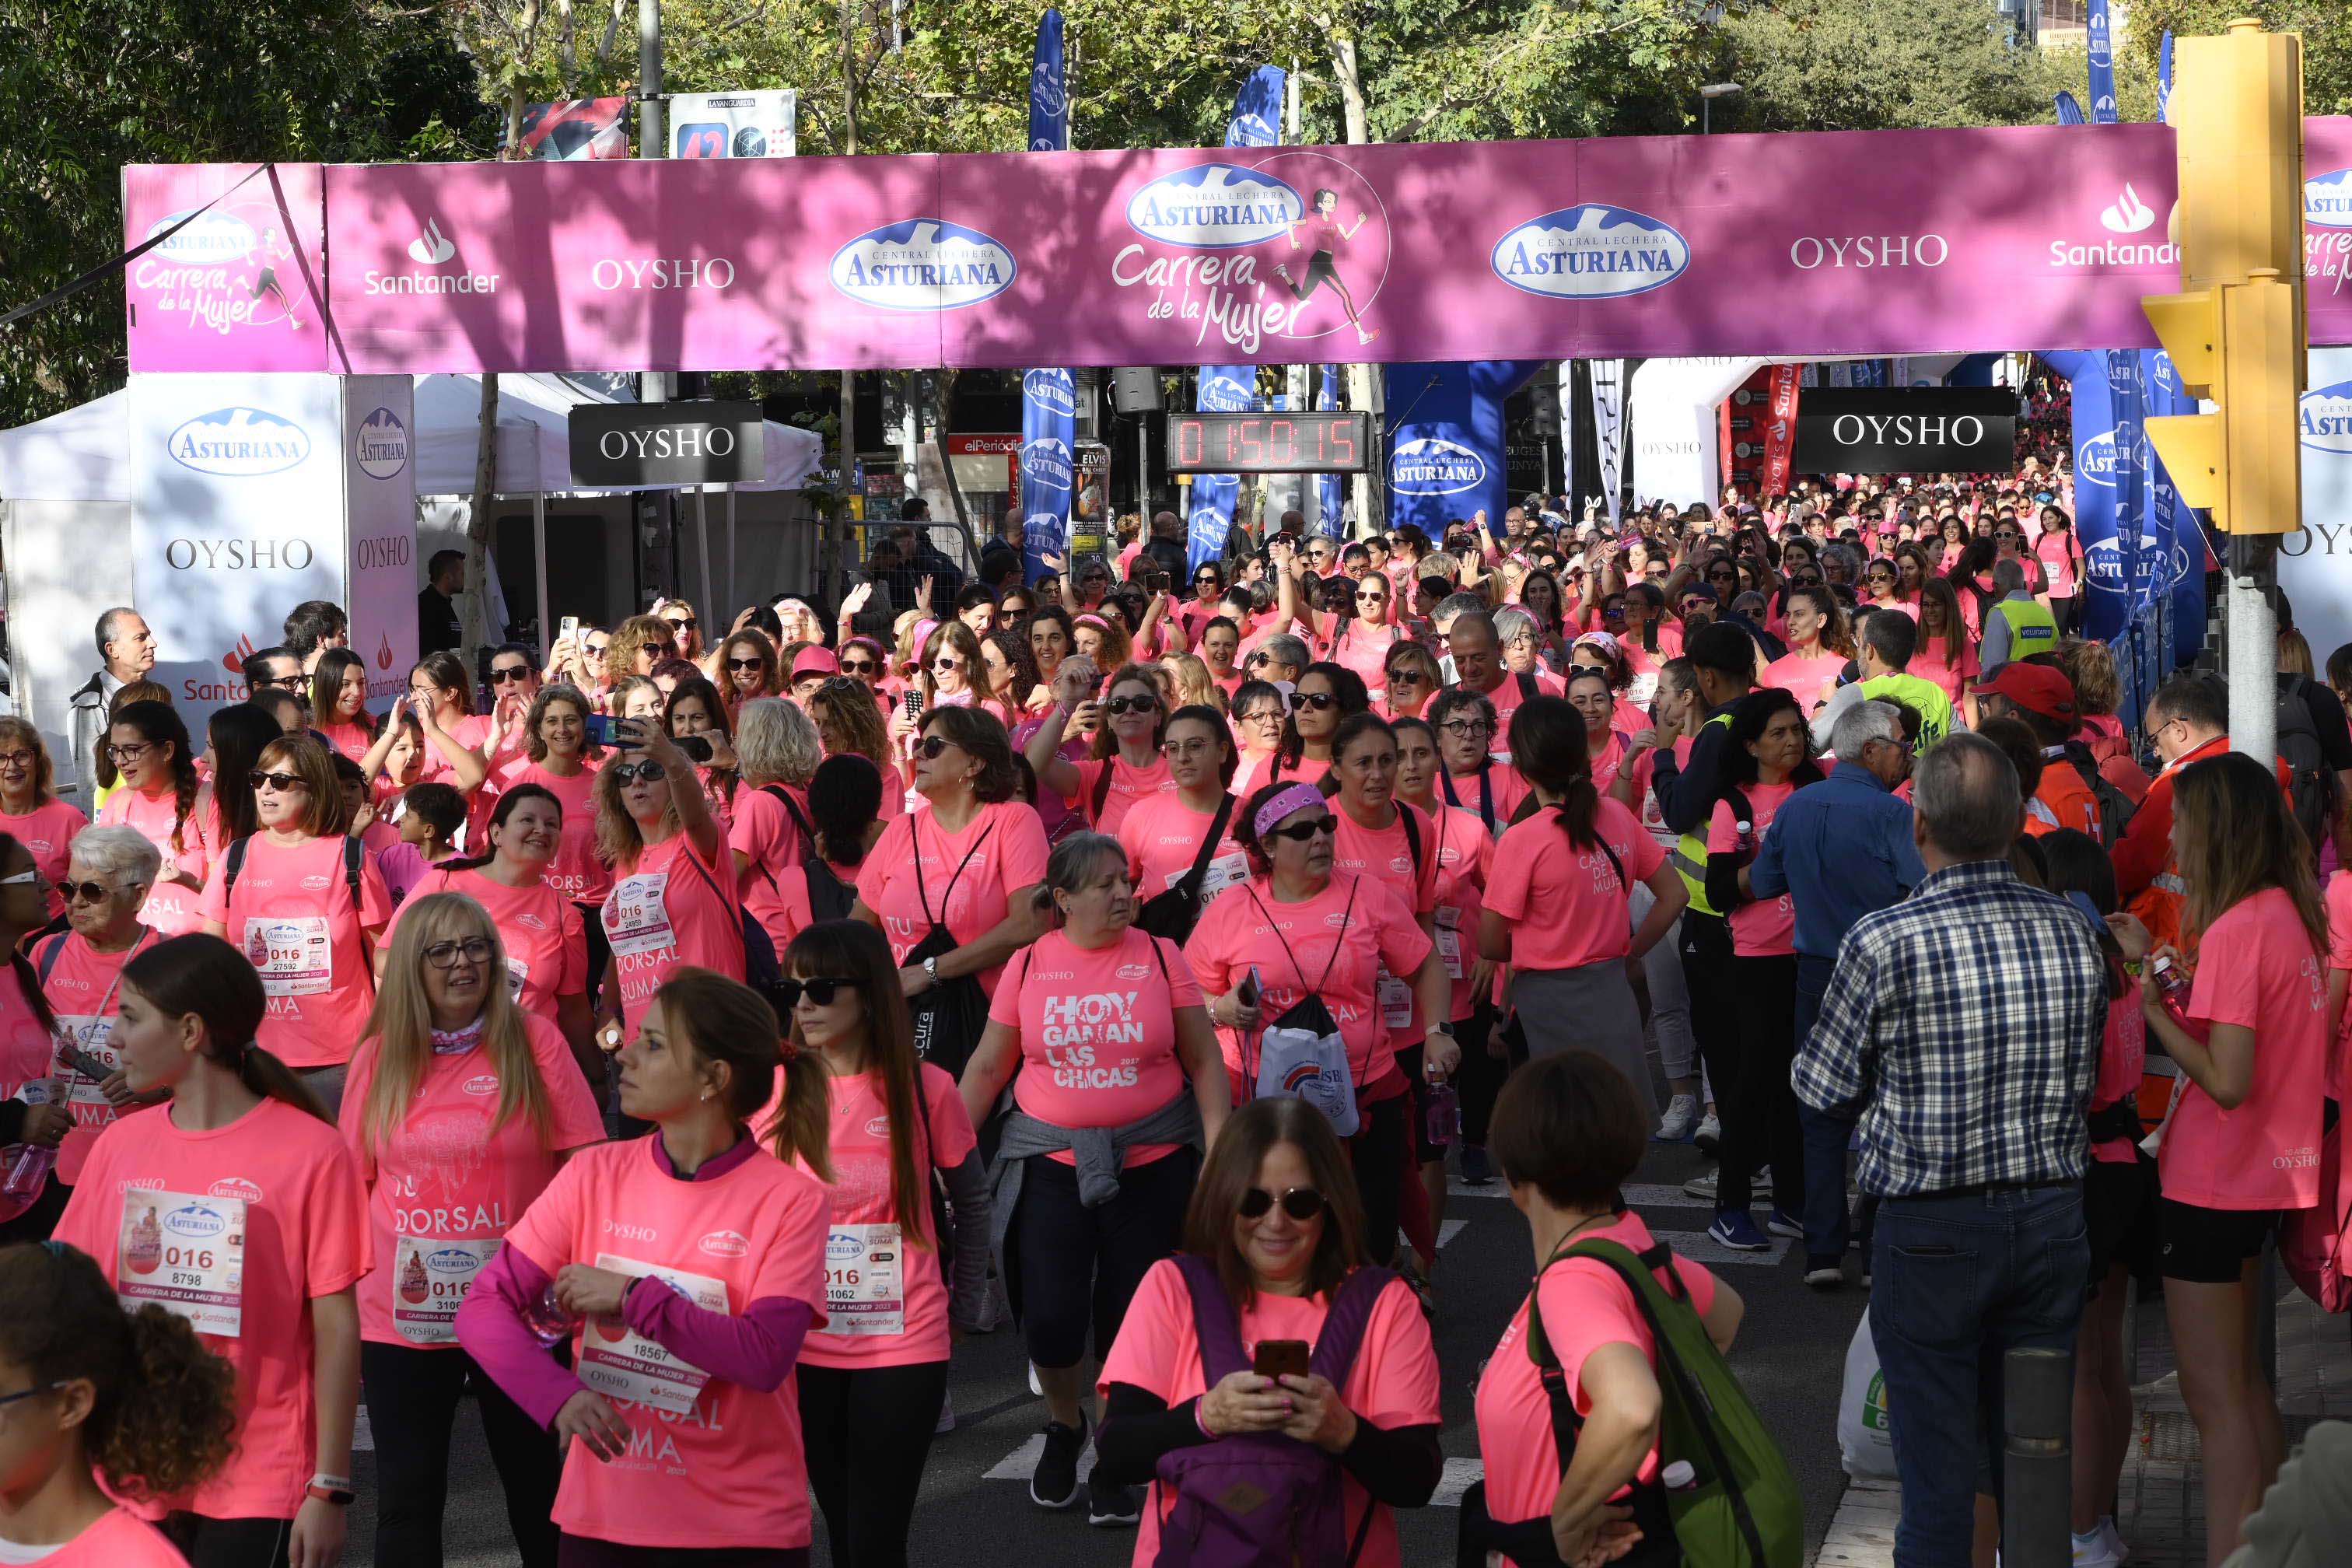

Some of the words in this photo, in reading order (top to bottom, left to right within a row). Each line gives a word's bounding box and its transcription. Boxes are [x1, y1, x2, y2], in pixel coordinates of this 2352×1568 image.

[1140, 195, 1289, 226] ASTURIANA
[1538, 236, 1598, 247] CENTRAL
[1605, 236, 1668, 245] LECHERA
[1790, 234, 1948, 269] OYSHO
[872, 250, 930, 260] CENTRAL
[1507, 240, 1675, 275] ASTURIANA
[135, 259, 228, 290] Carrera
[592, 258, 735, 290] OYSHO
[845, 253, 1002, 286] ASTURIANA
[1112, 244, 1258, 288] Carrera
[2323, 257, 2336, 276] la
[365, 270, 499, 295] Santander
[158, 289, 174, 310] de
[179, 290, 191, 311] la
[189, 286, 262, 334] Mujer
[1147, 289, 1174, 320] de
[1181, 289, 1200, 320] la
[1195, 281, 1314, 355] Mujer
[1833, 414, 1984, 446] OYSHO
[180, 433, 299, 459] ASTURIANA
[359, 435, 404, 461] ASTURIANA
[600, 427, 734, 460] OYSHO
[1643, 440, 1701, 455] OYSHO
[1082, 454, 1107, 464] ELVIS
[1391, 465, 1478, 482] ASTURIANA
[166, 538, 313, 570] OYSHO
[358, 536, 409, 570] OYSHO
[1159, 836, 1192, 845] OYSHO
[1592, 864, 1608, 880] DE
[1593, 878, 1622, 894] MUJE
[621, 905, 642, 919] 016
[268, 930, 302, 940] ASTURIANA
[887, 915, 912, 936] TU
[271, 949, 300, 960] 016
[616, 946, 681, 976] DORSAL
[54, 978, 89, 991] OYSHO
[1032, 971, 1074, 981] OYSHO
[265, 996, 299, 1013] MA
[1043, 992, 1138, 1025] HOY
[1043, 1022, 1143, 1046] GANAN
[1045, 1046, 1096, 1067] LAS
[1054, 1066, 1138, 1089] CHICAS
[168, 1218, 219, 1232] ASTURIANA
[394, 1202, 506, 1234] DORSAL
[603, 1219, 656, 1243] OYSHO
[166, 1247, 213, 1269] 016
[429, 1258, 474, 1267] ASTURIANA
[172, 1272, 202, 1286] 8798
[129, 1286, 170, 1297] CARRERA
[170, 1290, 182, 1298] DE
[183, 1291, 194, 1300] LA
[195, 1293, 223, 1302] MUJER
[698, 1294, 723, 1308] SUMA
[404, 1326, 440, 1336] OYSHO
[856, 1318, 894, 1326] Santander
[633, 1343, 669, 1362] 18567
[597, 1353, 632, 1370] CARRERA
[632, 1362, 643, 1373] DE
[644, 1363, 656, 1375] LA
[656, 1367, 684, 1381] MUJER
[590, 1370, 629, 1389] OYSHO
[628, 1426, 683, 1464] MA
